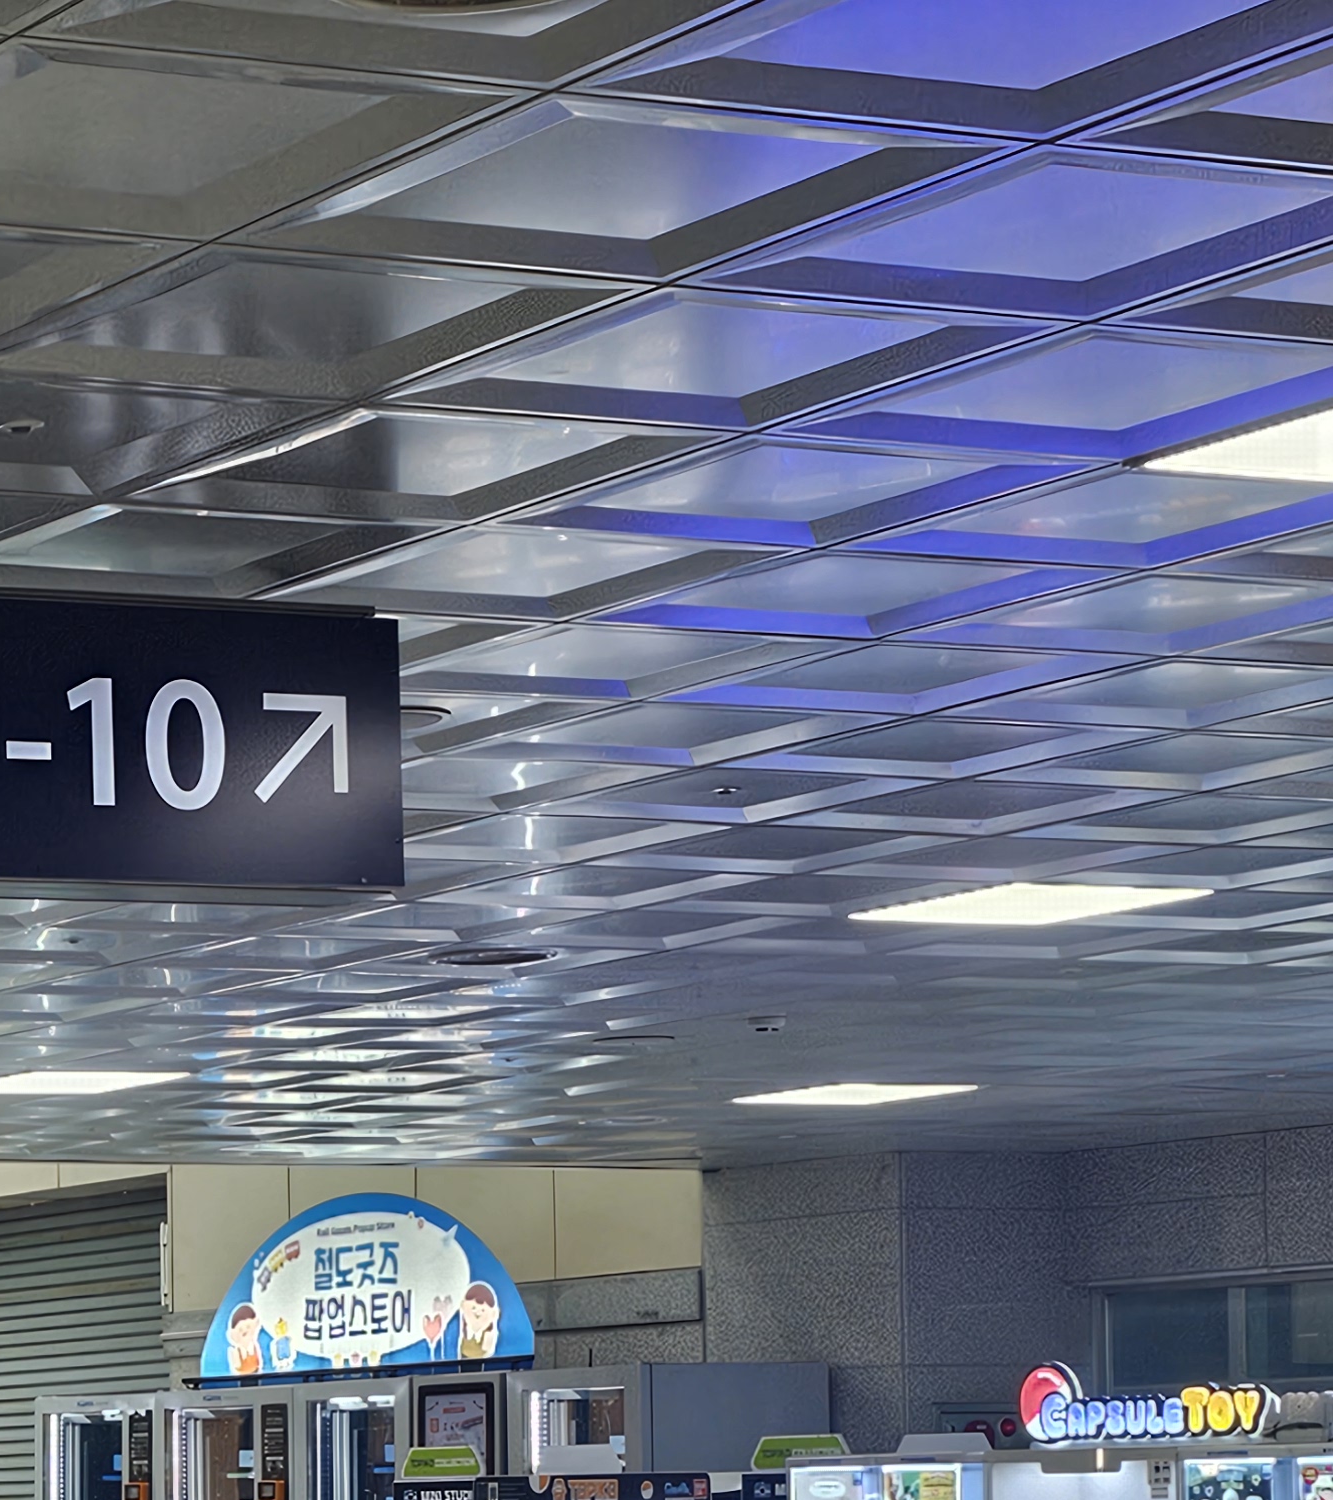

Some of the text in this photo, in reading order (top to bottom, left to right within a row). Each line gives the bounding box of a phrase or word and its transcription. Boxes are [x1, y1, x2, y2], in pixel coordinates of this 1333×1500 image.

[314, 1242, 400, 1291] 철도굿즈
[303, 1289, 412, 1341] 팝업스토어
[1040, 1386, 1261, 1440] CAPSULE TOY
